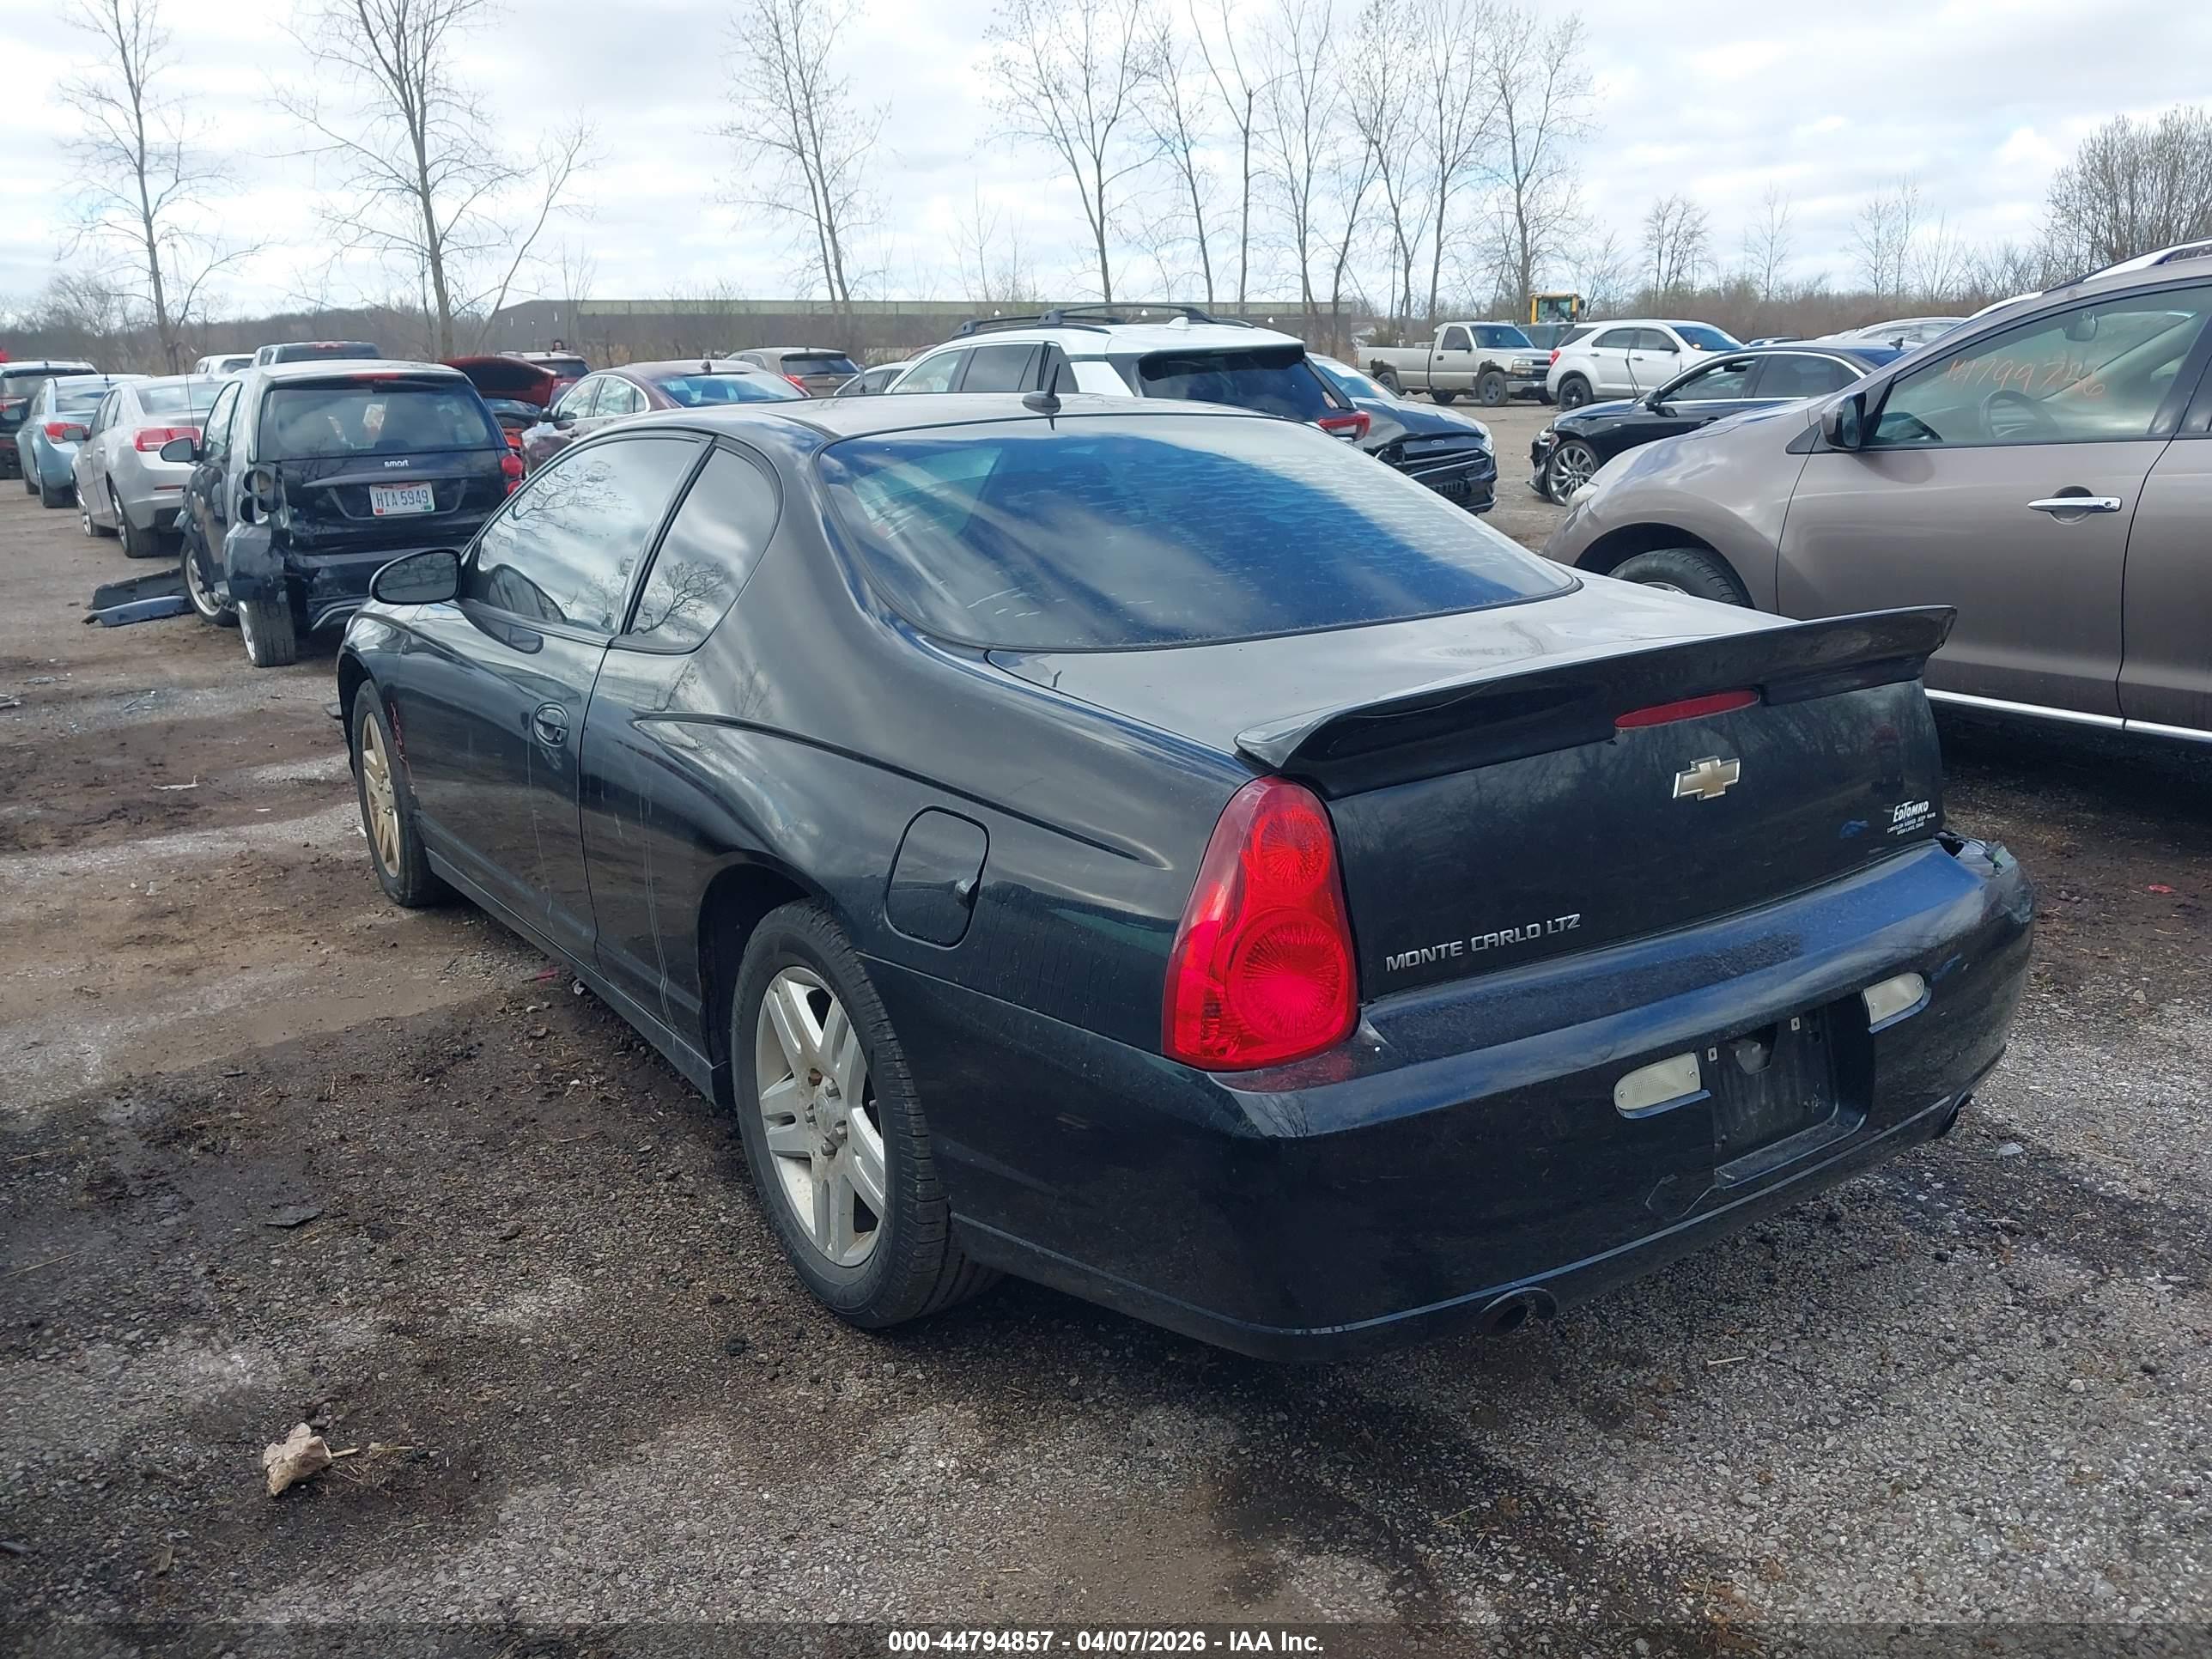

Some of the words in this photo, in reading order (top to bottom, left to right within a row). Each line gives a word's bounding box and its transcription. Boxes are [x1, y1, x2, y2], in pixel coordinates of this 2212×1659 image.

[400, 489, 429, 506] 5949
[1385, 940, 1463, 972] MONTE
[1470, 923, 1541, 952] CARLO
[1546, 913, 1581, 935] LTZ
